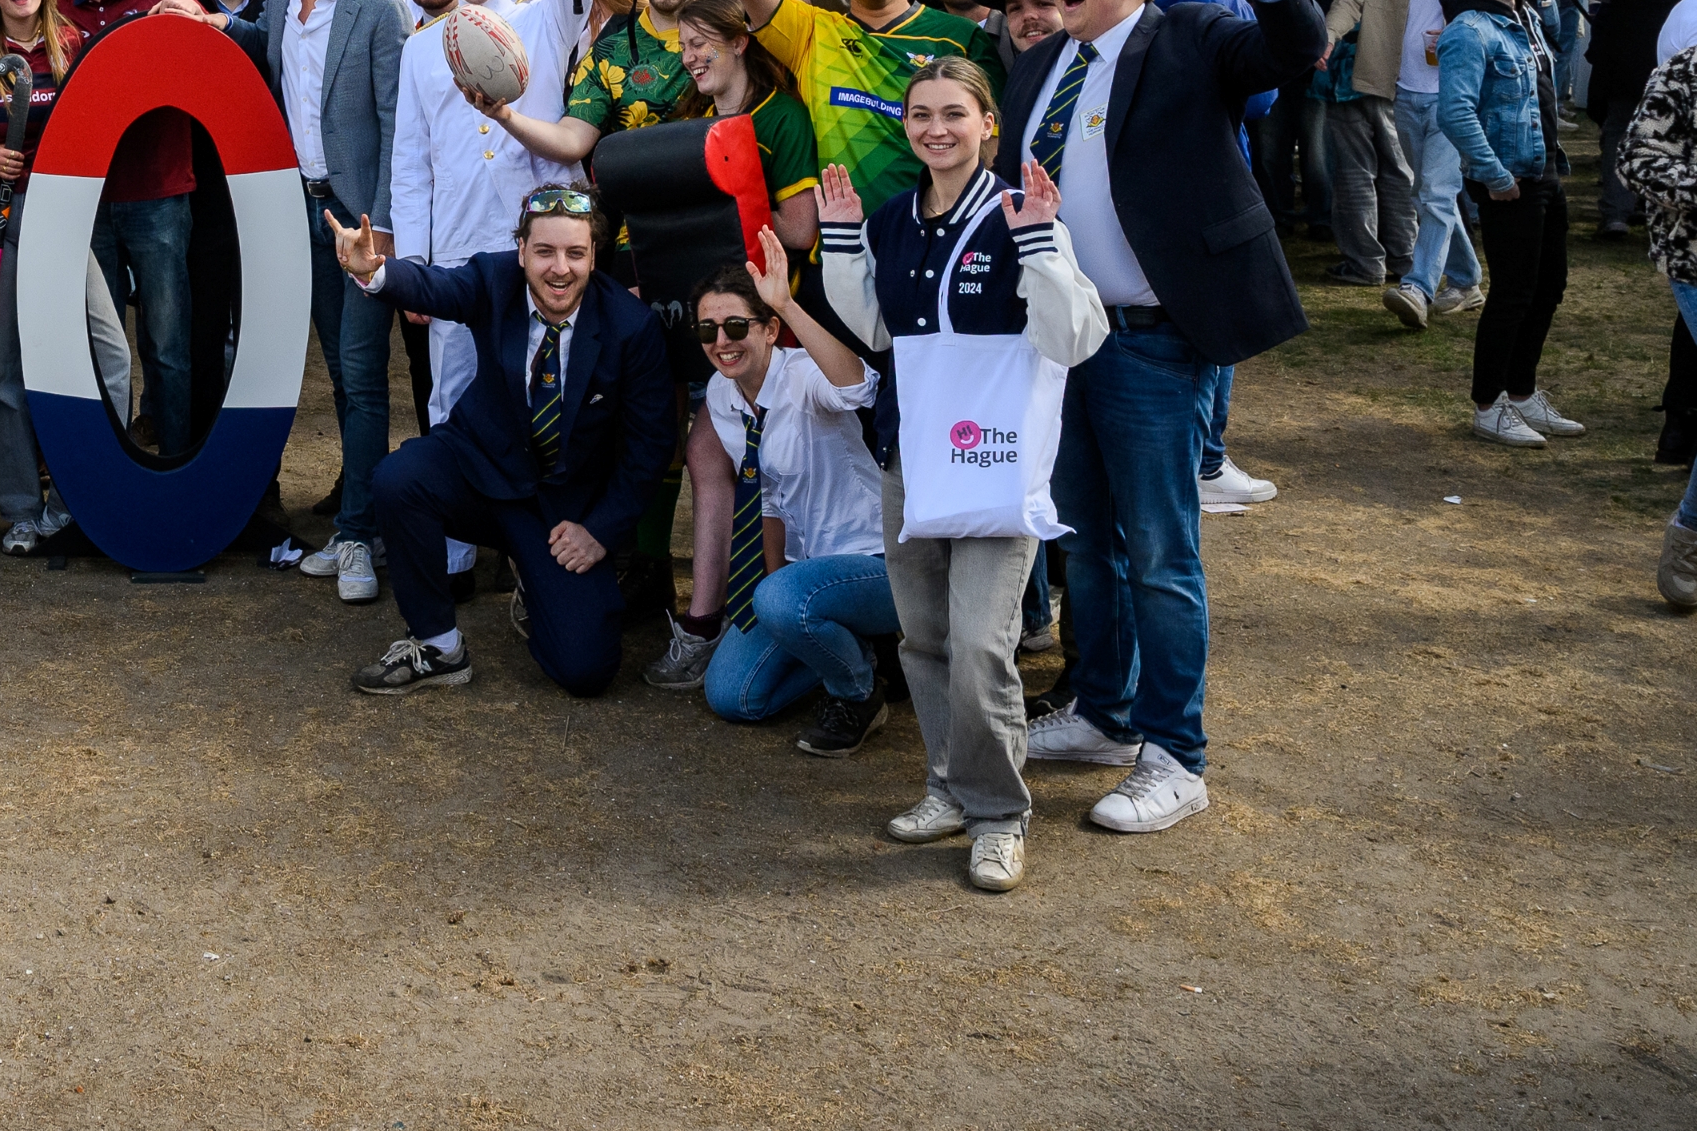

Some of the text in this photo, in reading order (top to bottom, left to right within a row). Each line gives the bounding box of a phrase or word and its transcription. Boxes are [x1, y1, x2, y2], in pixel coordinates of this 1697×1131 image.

[973, 252, 992, 263] The
[958, 282, 982, 294] 2024
[980, 427, 1018, 445] The
[951, 448, 1018, 468] Hague
